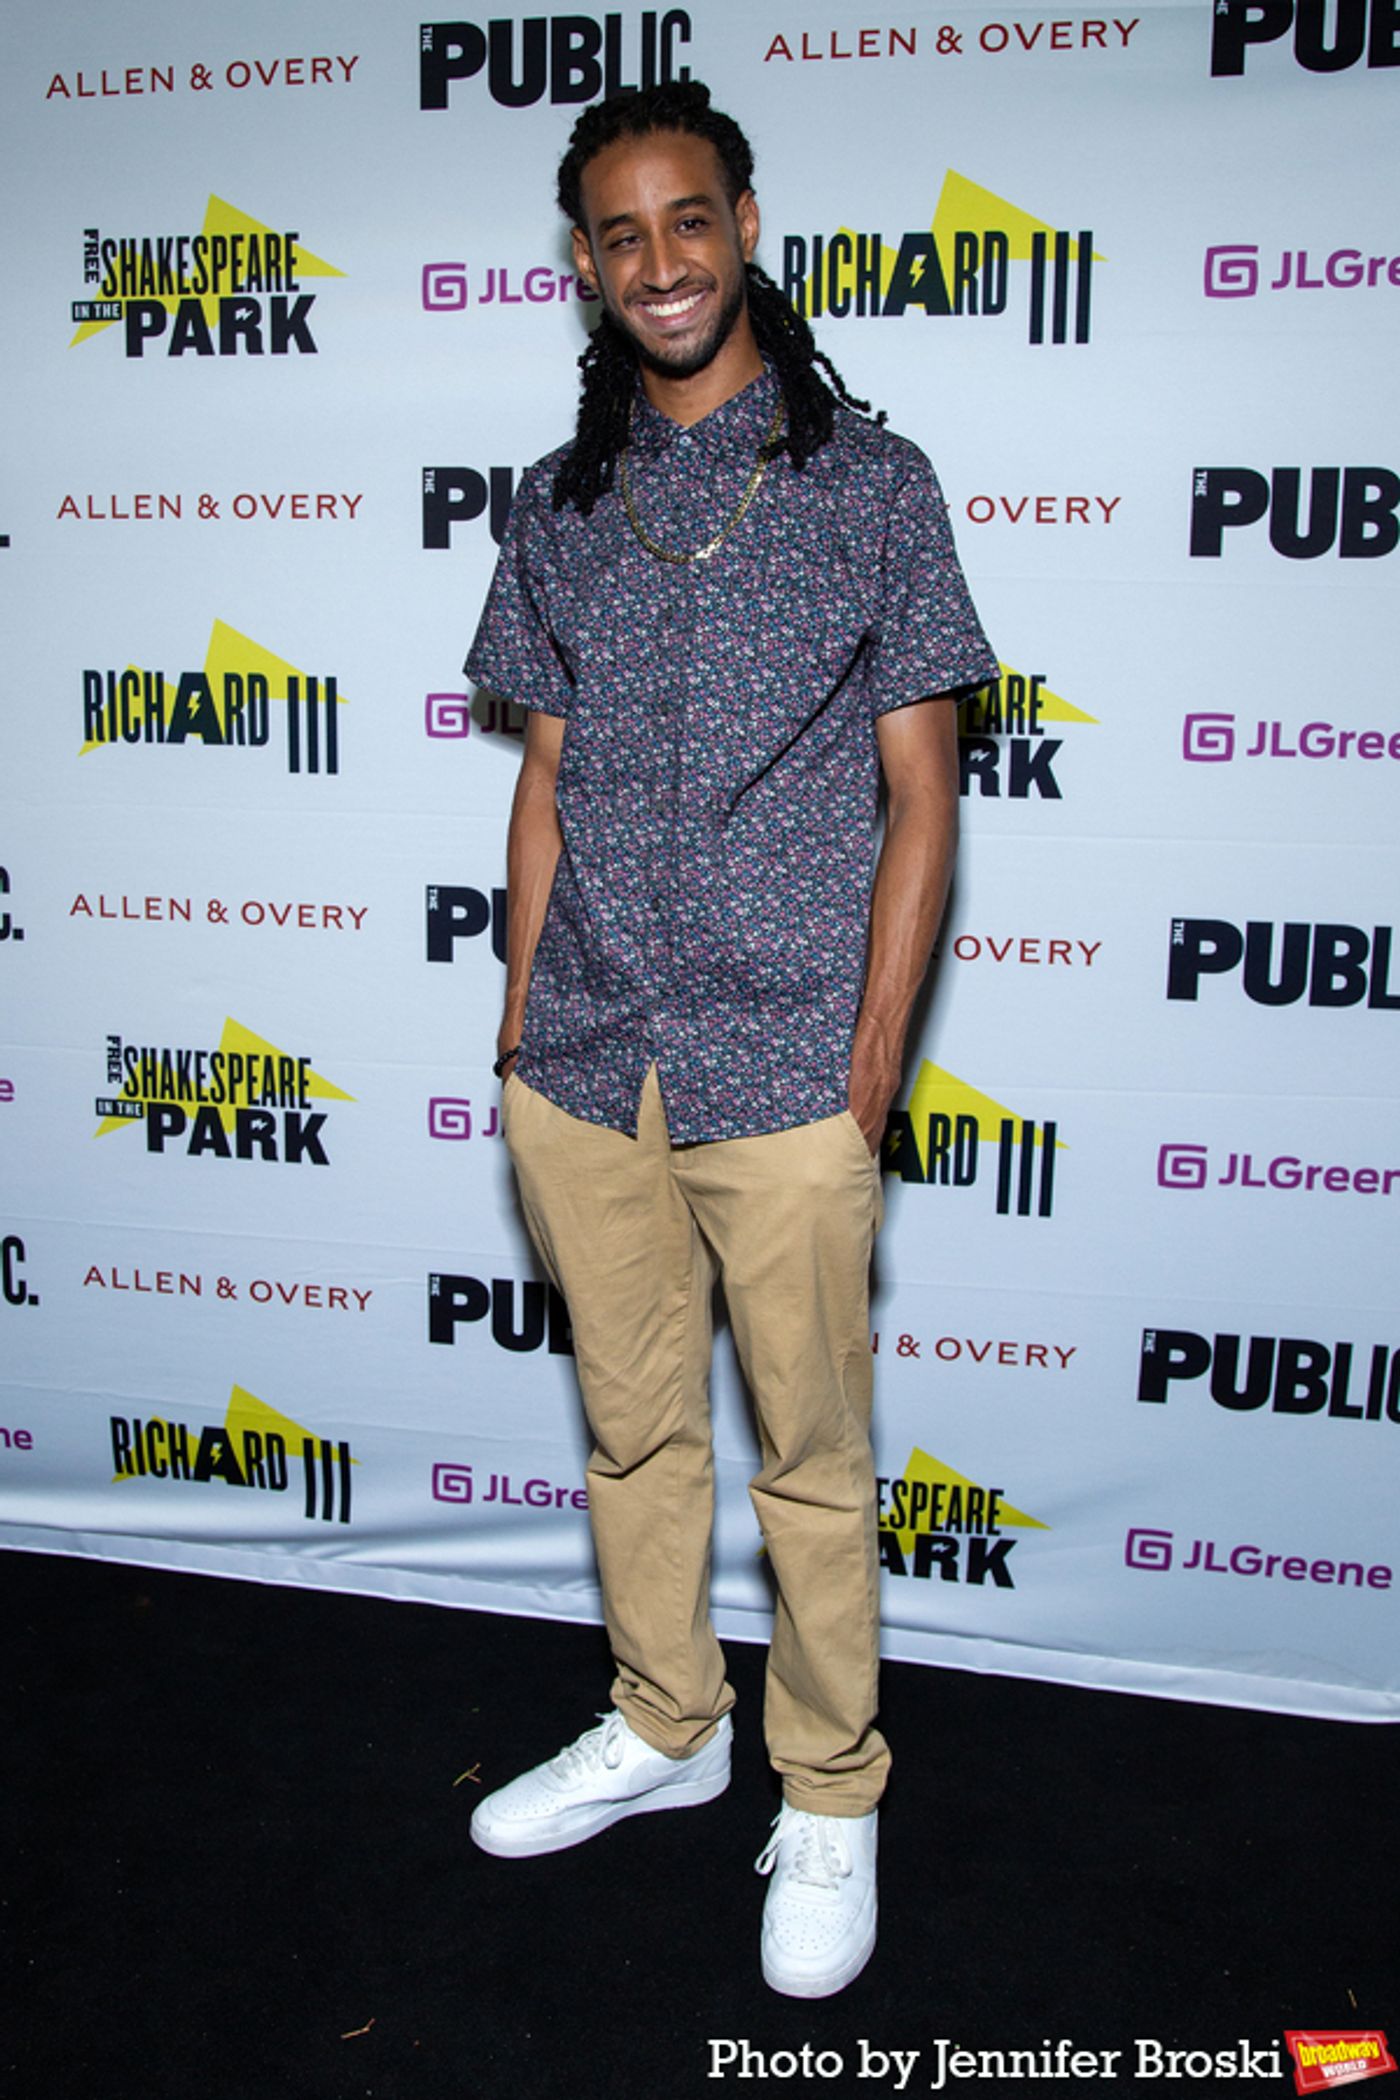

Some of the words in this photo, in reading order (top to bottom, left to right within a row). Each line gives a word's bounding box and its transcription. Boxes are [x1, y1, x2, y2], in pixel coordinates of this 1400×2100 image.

[764, 29, 916, 61] ALLEN
[936, 25, 963, 56] &
[979, 20, 1139, 53] OVERY
[46, 66, 175, 99] ALLEN
[190, 64, 213, 91] &
[226, 56, 359, 89] OVERY
[83, 228, 100, 283] FREE
[101, 232, 300, 298] SHAKESPEARE
[74, 303, 90, 319] IN
[95, 303, 121, 319] THE
[784, 231, 1009, 318] RICHARD
[1029, 231, 1093, 345] III
[125, 294, 318, 358] PARK
[57, 495, 182, 520] ALLEN
[198, 494, 221, 520] &
[232, 494, 364, 520] OVERY
[966, 495, 1122, 525] OVERY
[83, 670, 269, 746] RICHARD
[287, 676, 338, 775] III
[70, 894, 192, 922] ALLEN
[206, 899, 228, 924] &
[241, 901, 369, 930] OVERY
[953, 934, 1103, 967] OVERY
[106, 1035, 122, 1084] FREE
[124, 1046, 312, 1109] SHAKESPEARE
[98, 1098, 114, 1114] IN
[118, 1101, 142, 1117] THE
[146, 1102, 330, 1165] PARK
[996, 1118, 1057, 1217] III
[84, 1265, 202, 1297] ALLEN
[216, 1276, 238, 1300] &
[249, 1281, 373, 1312] OVERY
[895, 1333, 920, 1359] &
[935, 1336, 1078, 1369] OVERY
[110, 1416, 288, 1492] RICHARD
[302, 1437, 351, 1524] III
[1183, 1541, 1393, 1589] JLGreene
